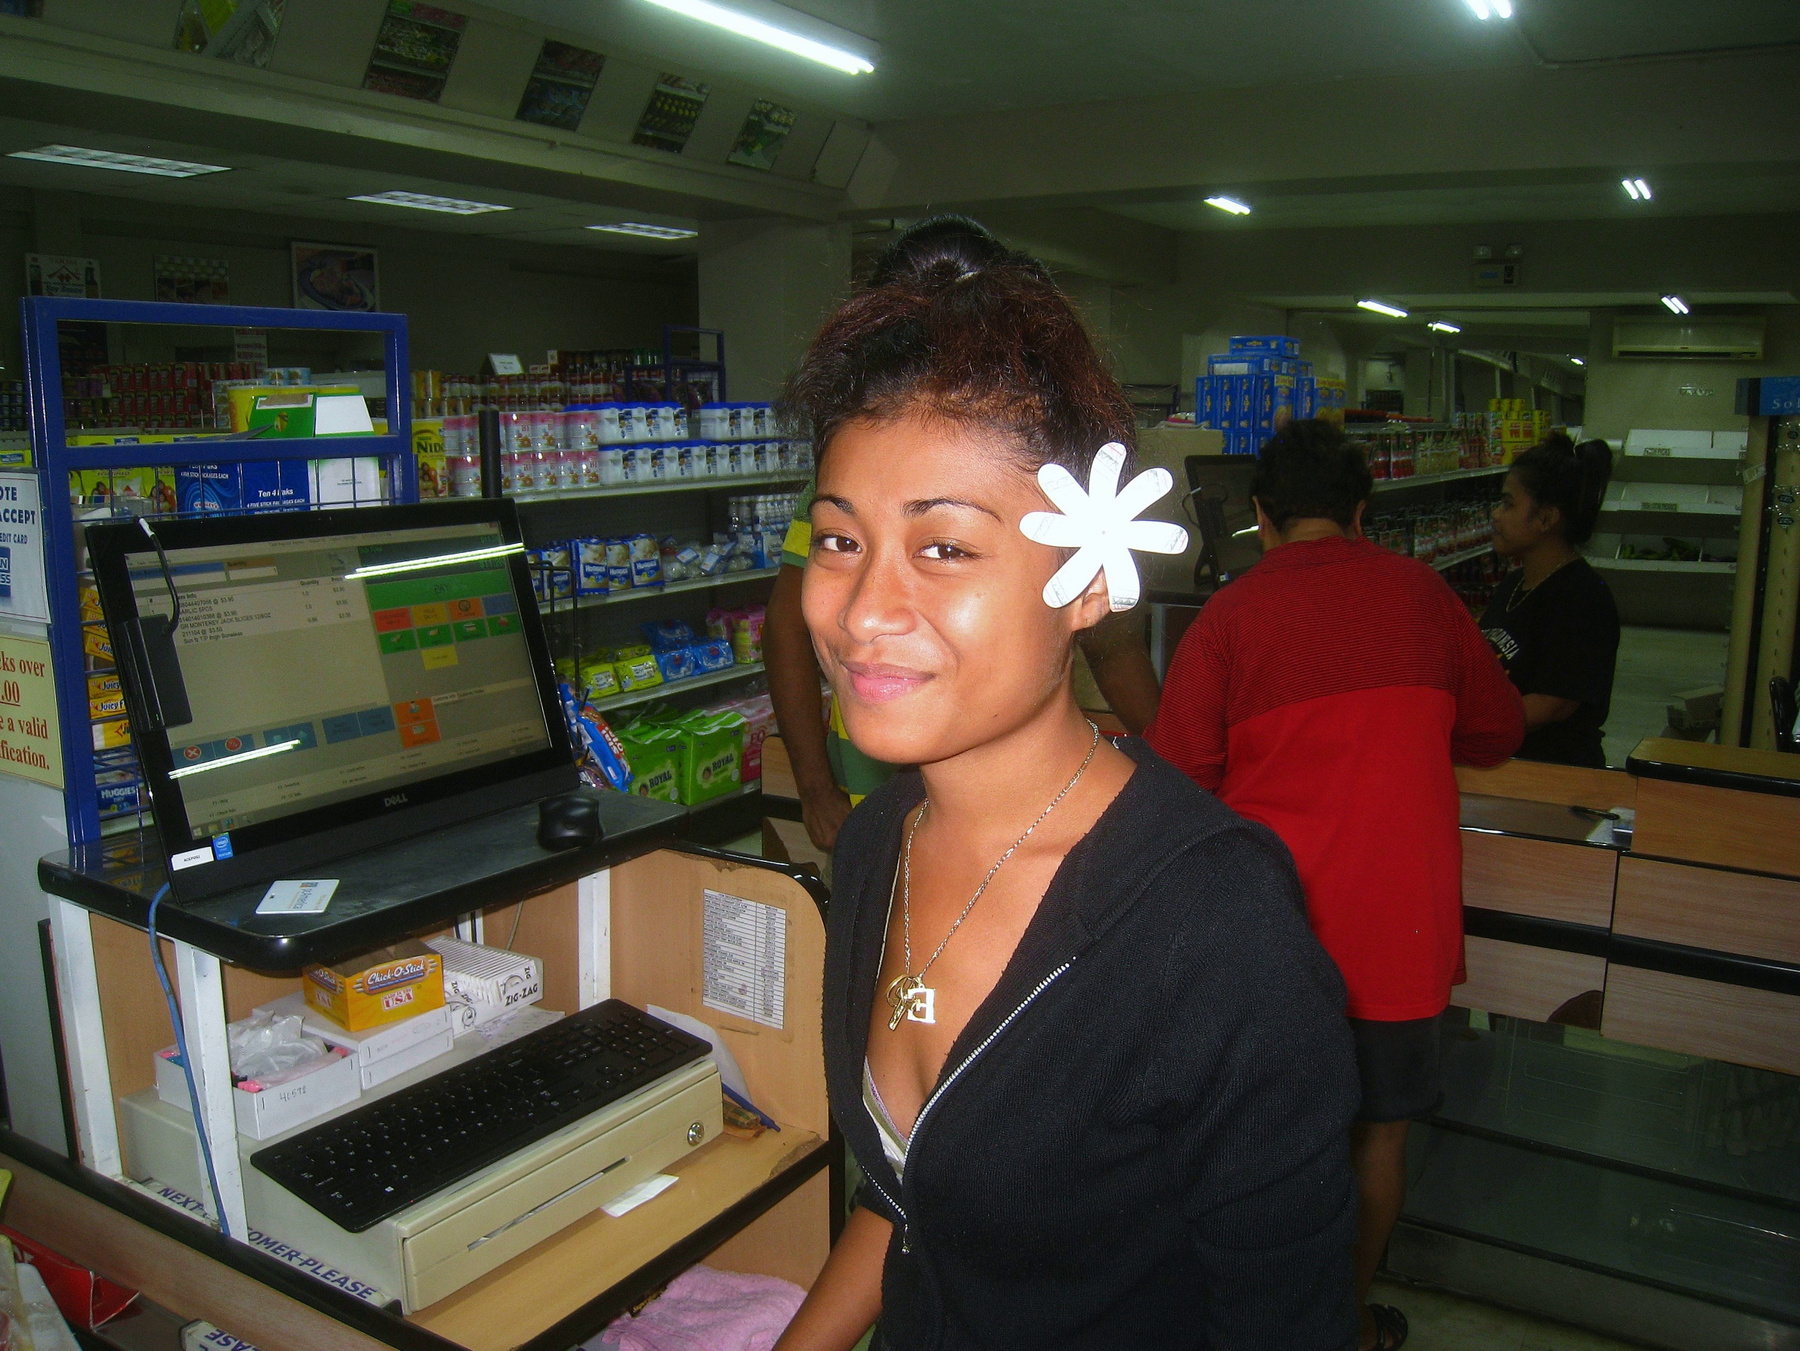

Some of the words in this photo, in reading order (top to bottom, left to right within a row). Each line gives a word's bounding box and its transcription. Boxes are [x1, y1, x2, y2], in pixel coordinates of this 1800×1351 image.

[1772, 397, 1800, 410] So
[258, 490, 271, 498] Ten
[272, 489, 276, 497] 4
[13, 533, 28, 545] CARD
[180, 607, 197, 615] ARLIC
[20, 659, 45, 678] over
[99, 701, 118, 712] Juicy
[7, 717, 15, 732] a
[18, 717, 48, 739] valid
[712, 753, 734, 772] ROYAL
[649, 770, 672, 789] ROYAL
[101, 786, 136, 799] HUGGIES
[384, 793, 408, 808] DELL
[367, 959, 425, 985] Chick-O-Stick
[524, 966, 532, 980] ZIG
[451, 981, 460, 994] ZIG
[384, 993, 413, 1009] USA
[505, 983, 538, 1007] ZIG-ZAG
